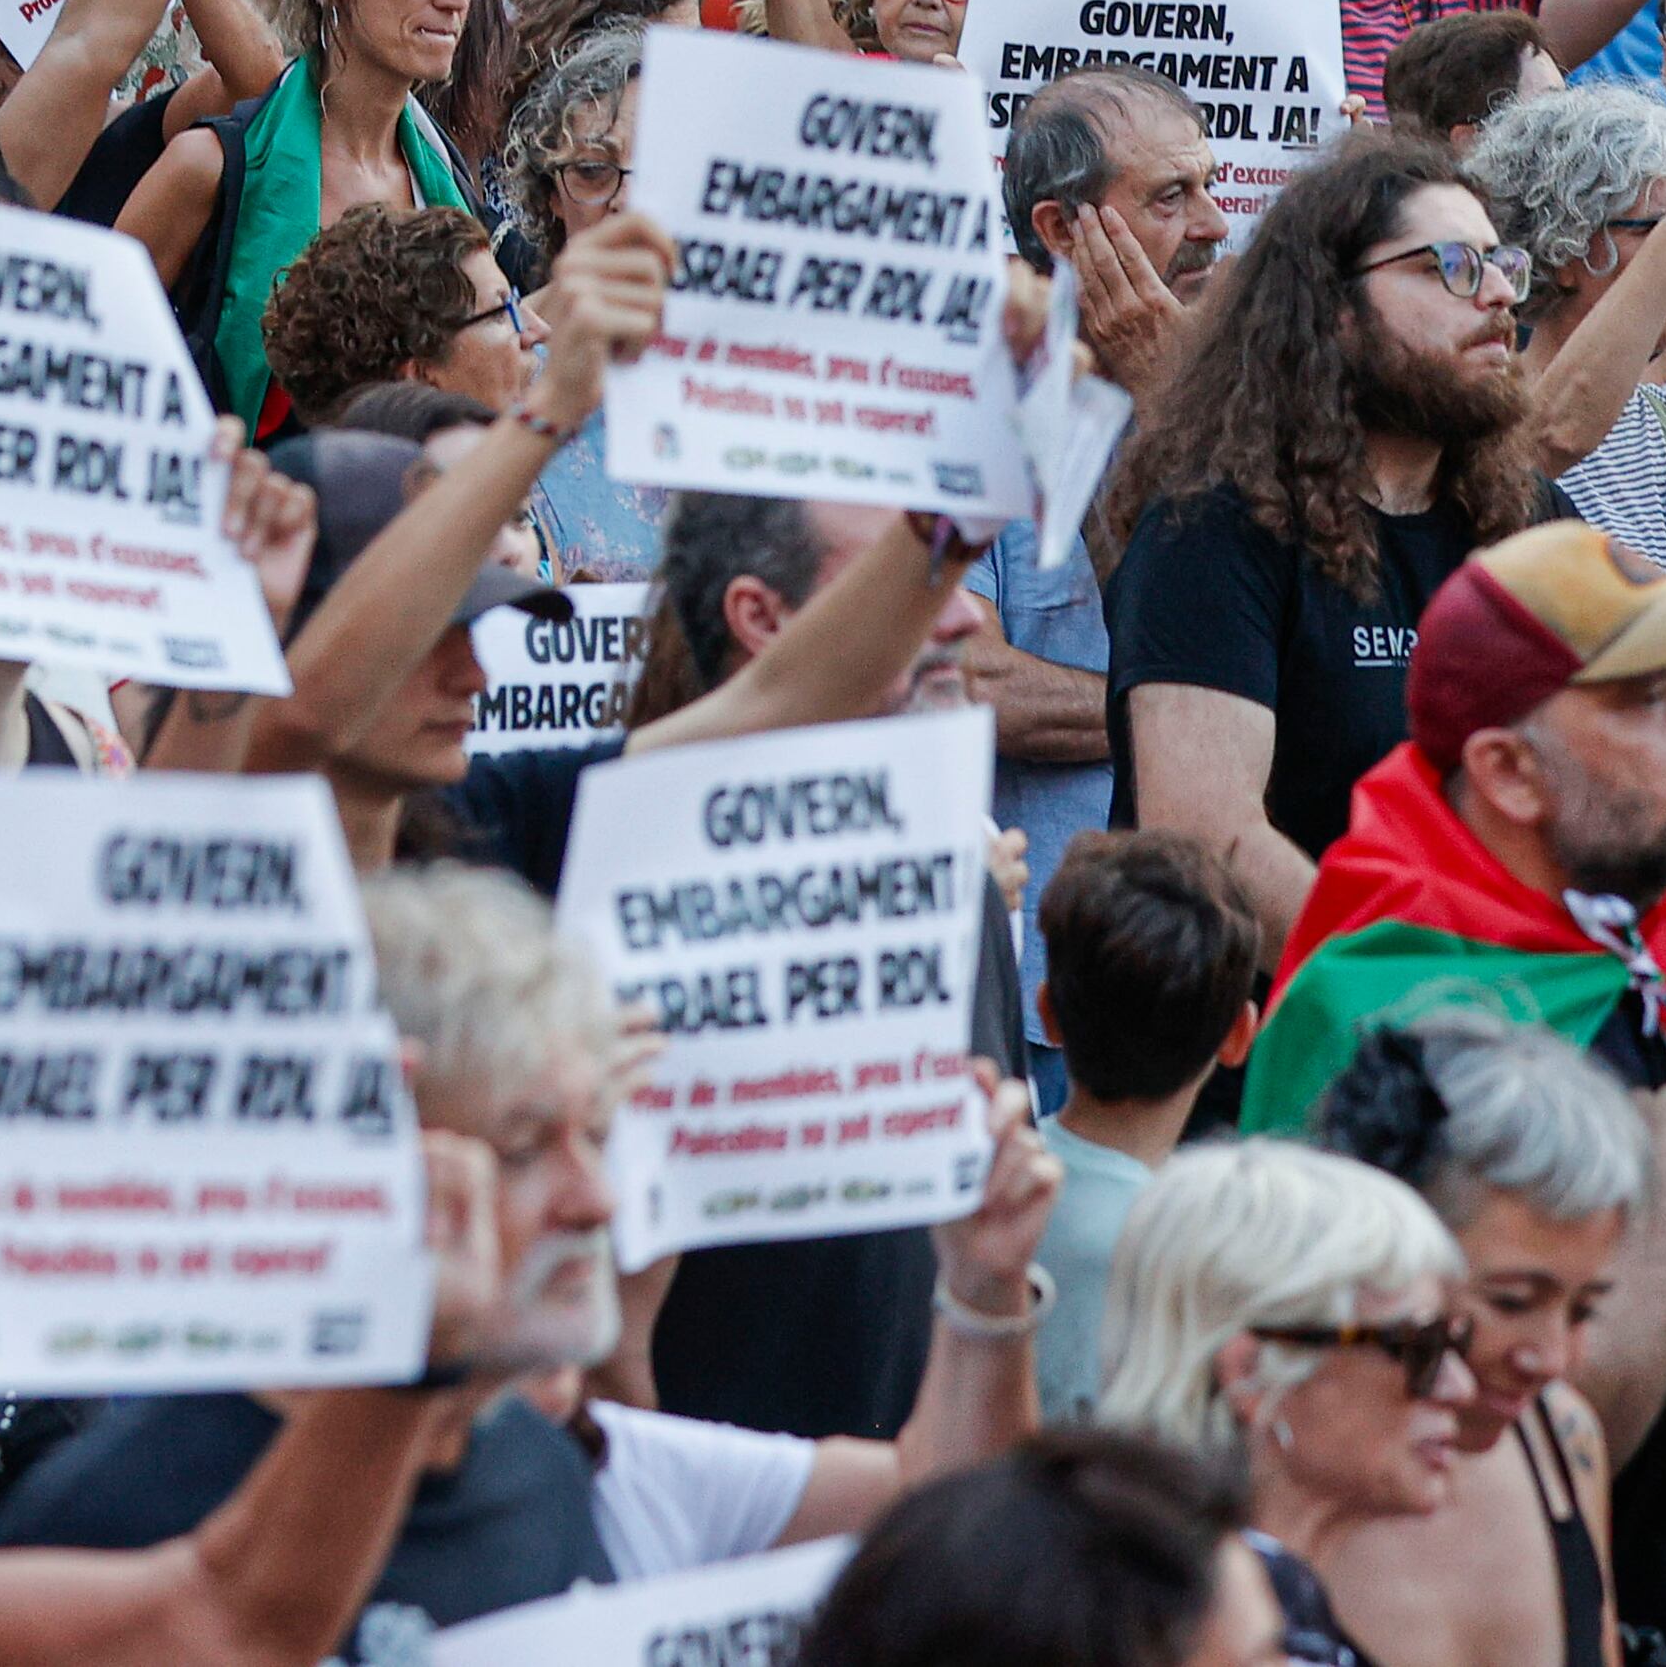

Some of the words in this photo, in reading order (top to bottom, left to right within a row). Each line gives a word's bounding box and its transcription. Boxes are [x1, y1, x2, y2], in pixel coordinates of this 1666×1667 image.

[1080, 0, 1234, 45] GOVERN,
[1285, 56, 1309, 92] A
[1269, 107, 1320, 144] JA!
[699, 157, 966, 248] EMBARGAMENT
[970, 196, 993, 254] A
[791, 257, 863, 322] PER
[863, 267, 932, 325] RDL
[937, 276, 991, 331] JA!
[160, 370, 187, 427] A
[51, 430, 128, 503] RDL
[147, 445, 202, 510] JA!
